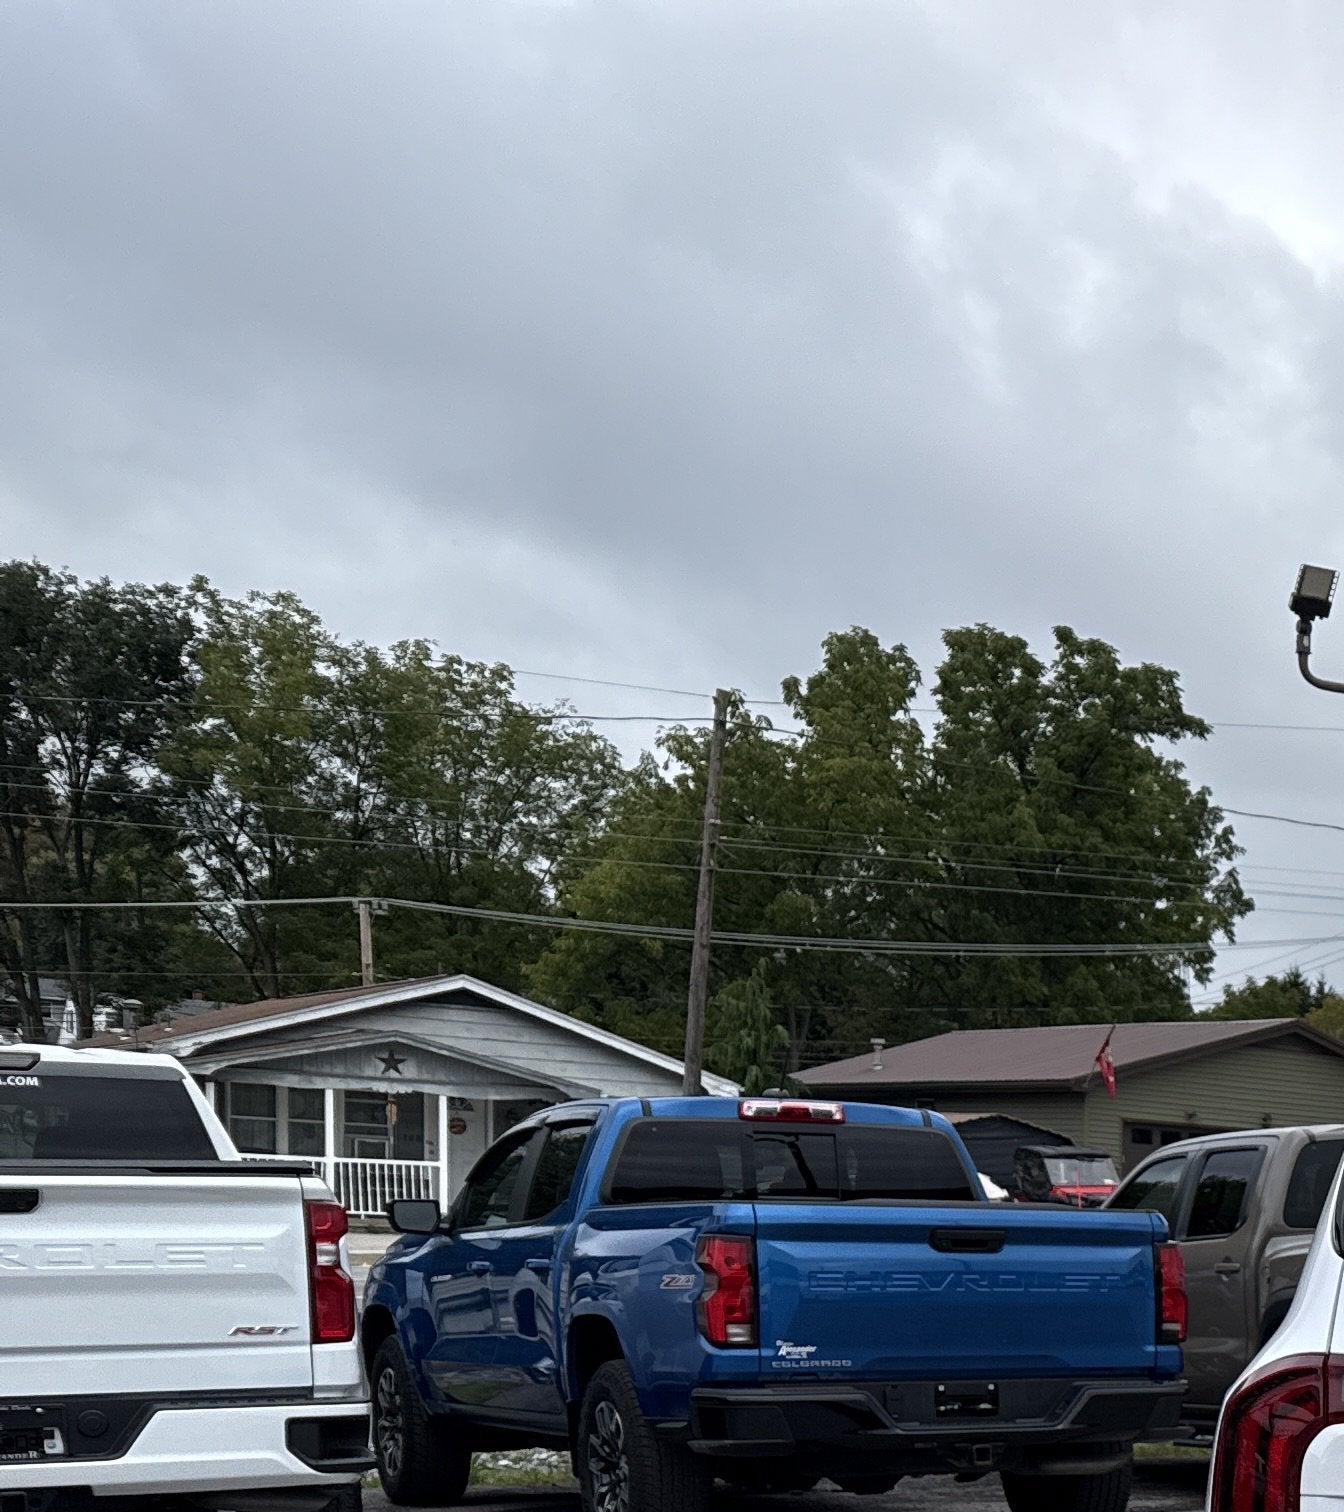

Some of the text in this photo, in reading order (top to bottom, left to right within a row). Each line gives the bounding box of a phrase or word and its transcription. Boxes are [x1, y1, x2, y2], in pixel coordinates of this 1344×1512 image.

[0, 1075, 39, 1086] .COM
[808, 1271, 1121, 1293] CHEVROLET
[226, 1325, 299, 1337] RST
[771, 1359, 853, 1369] COLORADO
